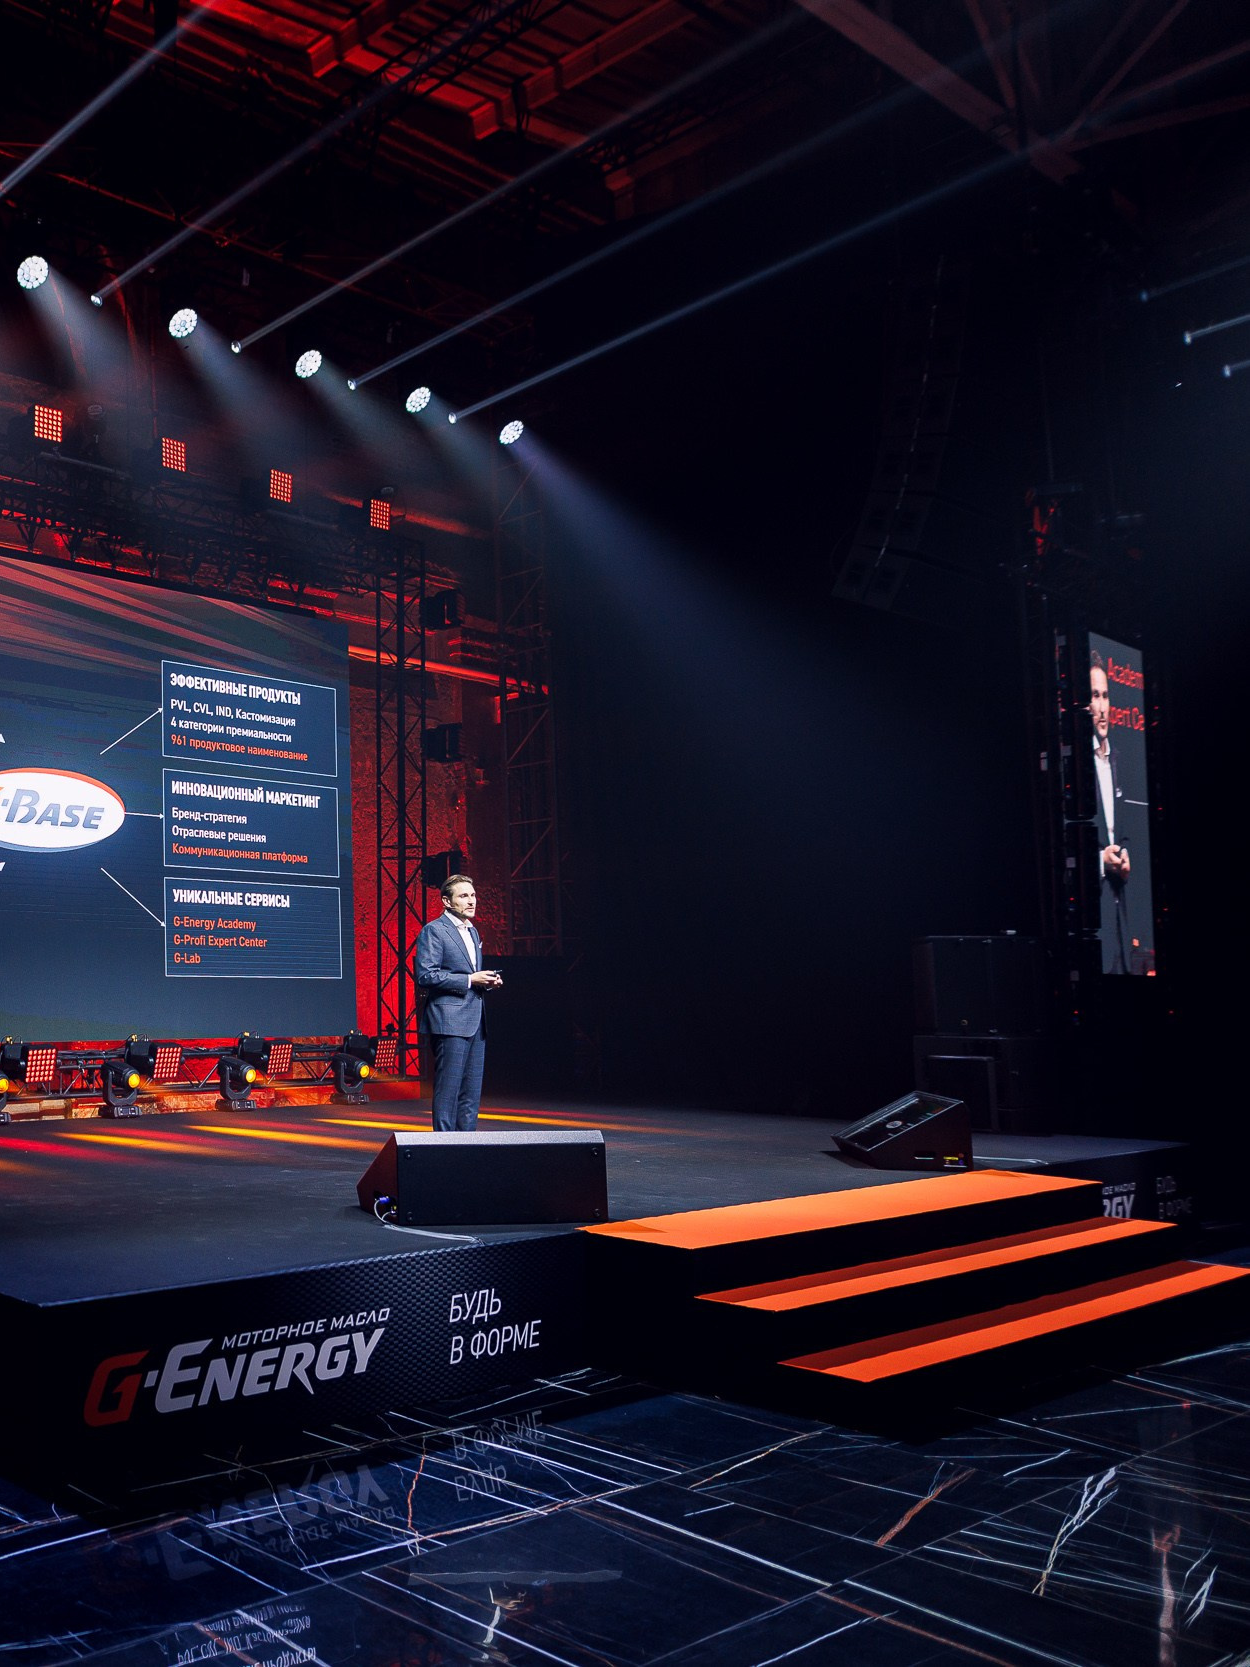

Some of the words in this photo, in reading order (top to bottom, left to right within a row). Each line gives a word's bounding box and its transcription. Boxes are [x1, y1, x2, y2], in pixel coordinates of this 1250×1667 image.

[170, 673, 247, 697] ЭФФЕКТИВНЫЕ
[248, 686, 301, 706] ПРОДУКТЫ
[170, 699, 191, 713] PVL,
[193, 702, 213, 716] CVL,
[215, 706, 234, 719] IND,
[235, 708, 296, 727] Кастомизация
[170, 717, 177, 727] 4
[179, 719, 224, 734] категории
[226, 726, 292, 743] премиальности
[171, 734, 187, 746] 961
[189, 738, 245, 754] продуктовое
[247, 746, 308, 761] наименование
[171, 780, 264, 803] ИННОВАЦИОННЫЙ
[265, 791, 321, 809] МАРКЕТИНГ
[172, 807, 247, 825] Бренд-стратегия
[172, 825, 226, 840] Отраслевые
[228, 832, 267, 843] решения
[172, 843, 260, 860] Коммуникационная
[262, 852, 308, 865] платформа
[172, 888, 243, 906] УНИКАЛЬНЫЕ
[244, 893, 290, 908] СЕРВИСЫ
[173, 916, 216, 931] G-Energy
[217, 918, 257, 932] Academy
[173, 934, 206, 946] G-Profi
[208, 936, 237, 948] Expert
[238, 937, 268, 948] Center
[174, 952, 201, 964] G-Lab
[450, 1288, 502, 1324] БУДЬ
[221, 1319, 325, 1351] МОТОРНОЕ
[330, 1308, 391, 1330] МАСЛО
[450, 1336, 464, 1365] В
[470, 1319, 542, 1360] ФОРМЕ
